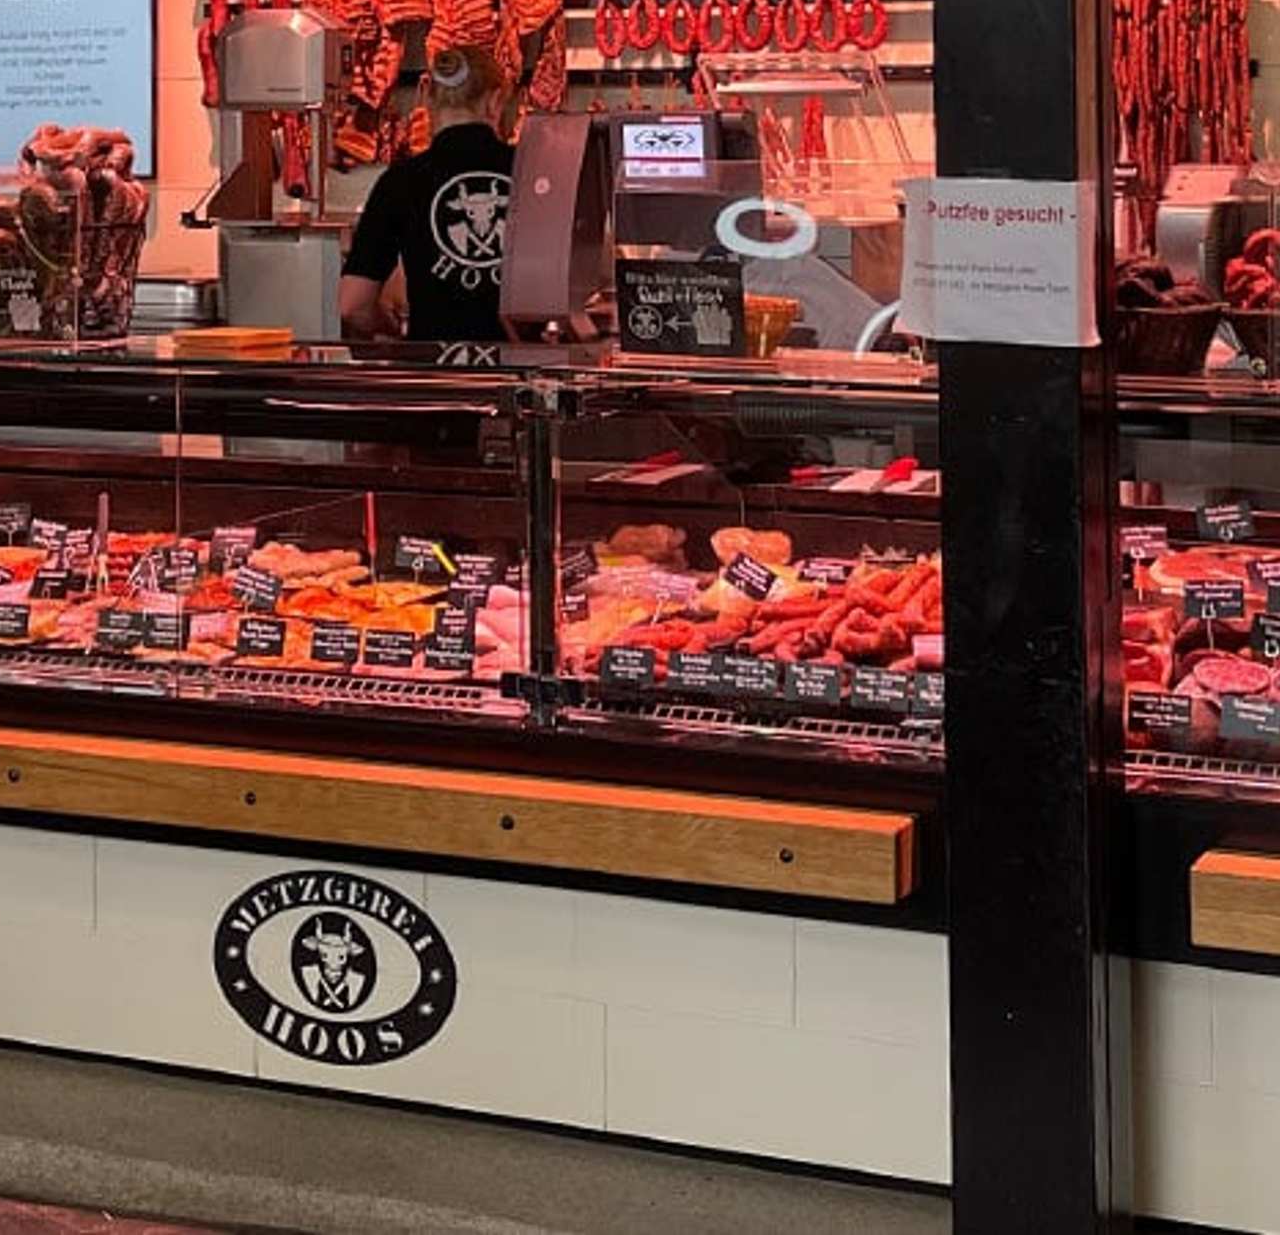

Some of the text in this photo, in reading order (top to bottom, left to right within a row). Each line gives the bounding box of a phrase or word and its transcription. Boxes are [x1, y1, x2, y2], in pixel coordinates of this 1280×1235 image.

[927, 199, 989, 221] Putzfee
[995, 205, 1064, 226] gesucht
[431, 255, 501, 290] HOO
[231, 876, 433, 952] METZGEREI
[263, 1004, 403, 1059] HOOS
